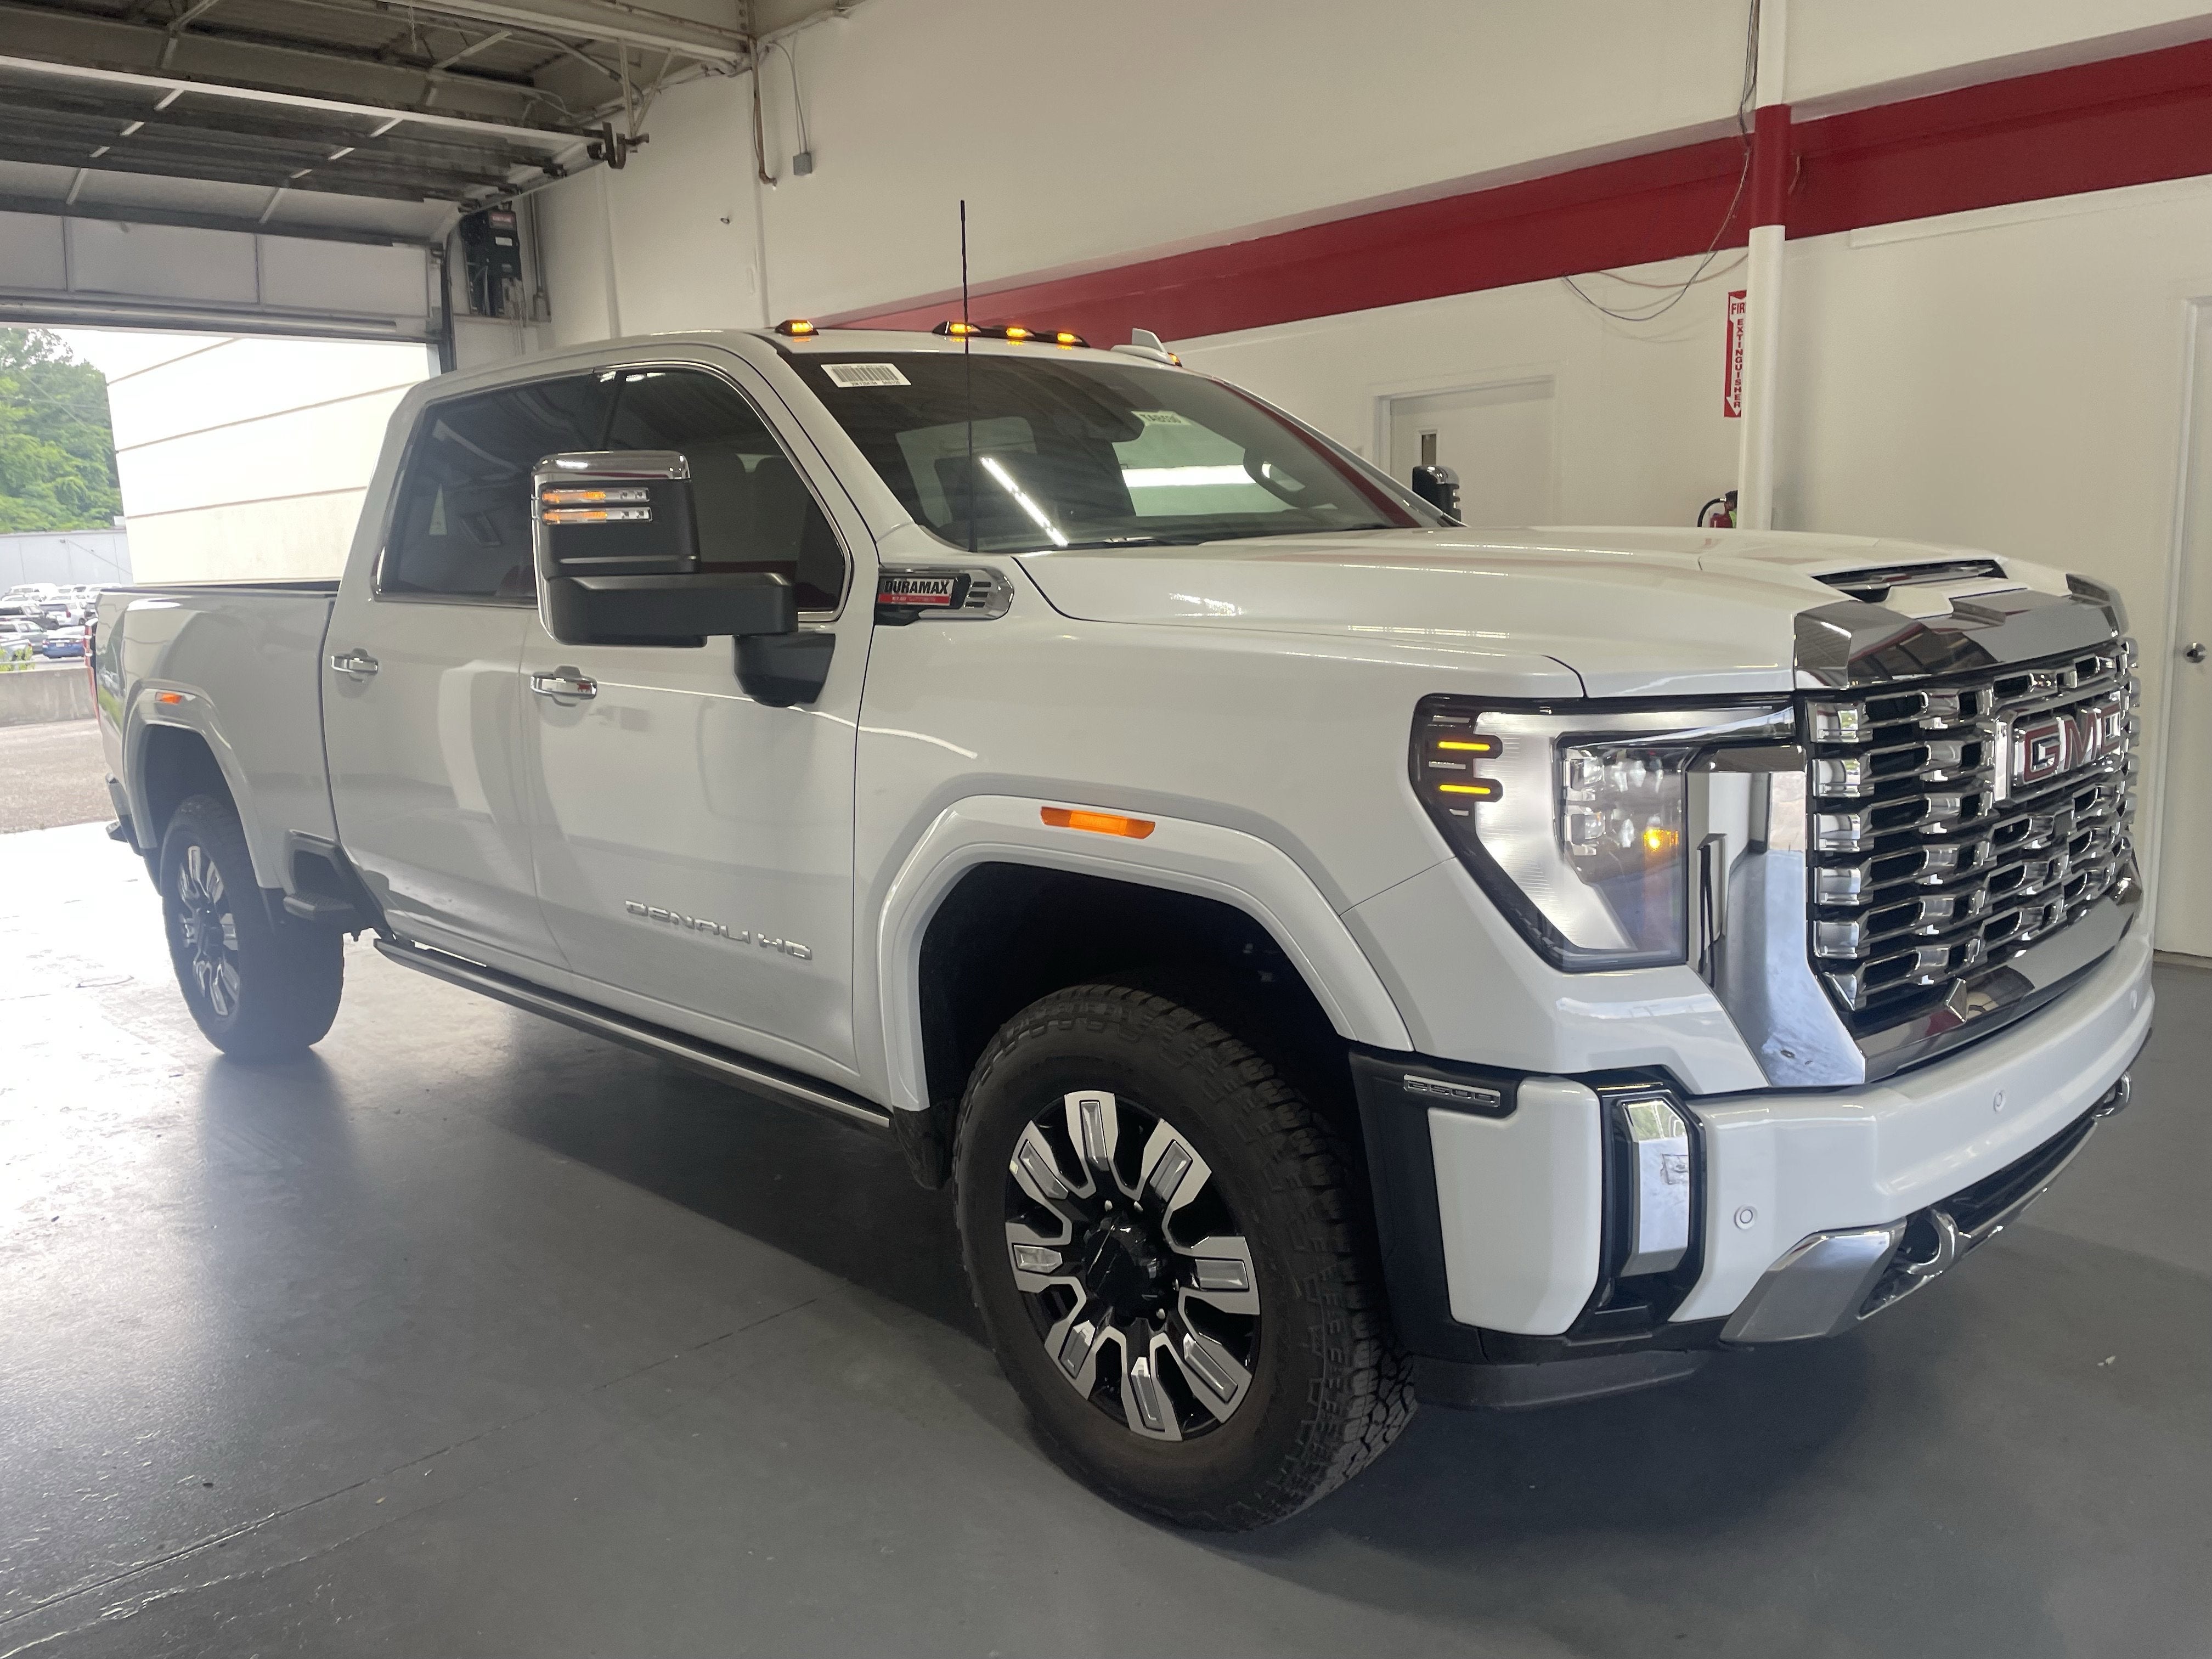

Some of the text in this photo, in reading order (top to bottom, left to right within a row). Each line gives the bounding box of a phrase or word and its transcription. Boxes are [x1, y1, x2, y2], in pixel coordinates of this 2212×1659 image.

[1731, 302, 1747, 314] FIR
[1734, 319, 1743, 408] EXTINGUISHER
[884, 579, 950, 594] DURAMAX
[2022, 702, 2121, 785] GMC
[625, 900, 812, 960] DENALI HD
